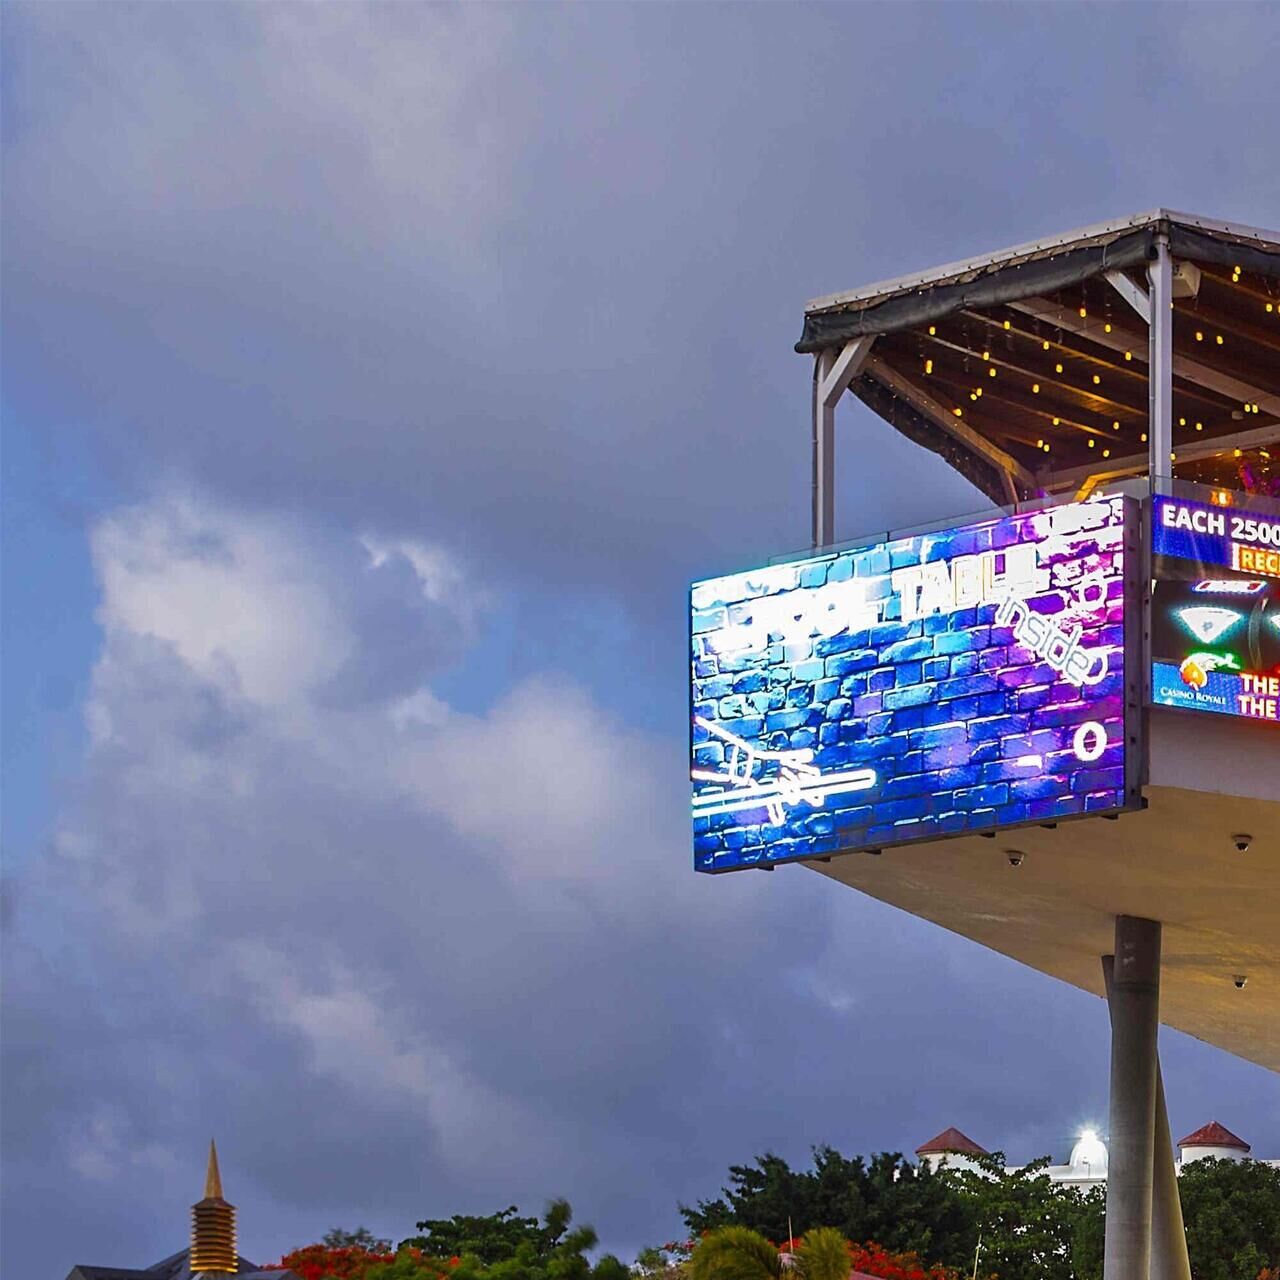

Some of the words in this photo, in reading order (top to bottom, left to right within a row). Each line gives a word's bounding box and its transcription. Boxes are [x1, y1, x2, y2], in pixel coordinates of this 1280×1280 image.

[1162, 504, 1225, 536] EACH
[996, 596, 1090, 685] inside
[1240, 672, 1279, 697] THE
[1238, 694, 1277, 719] THE
